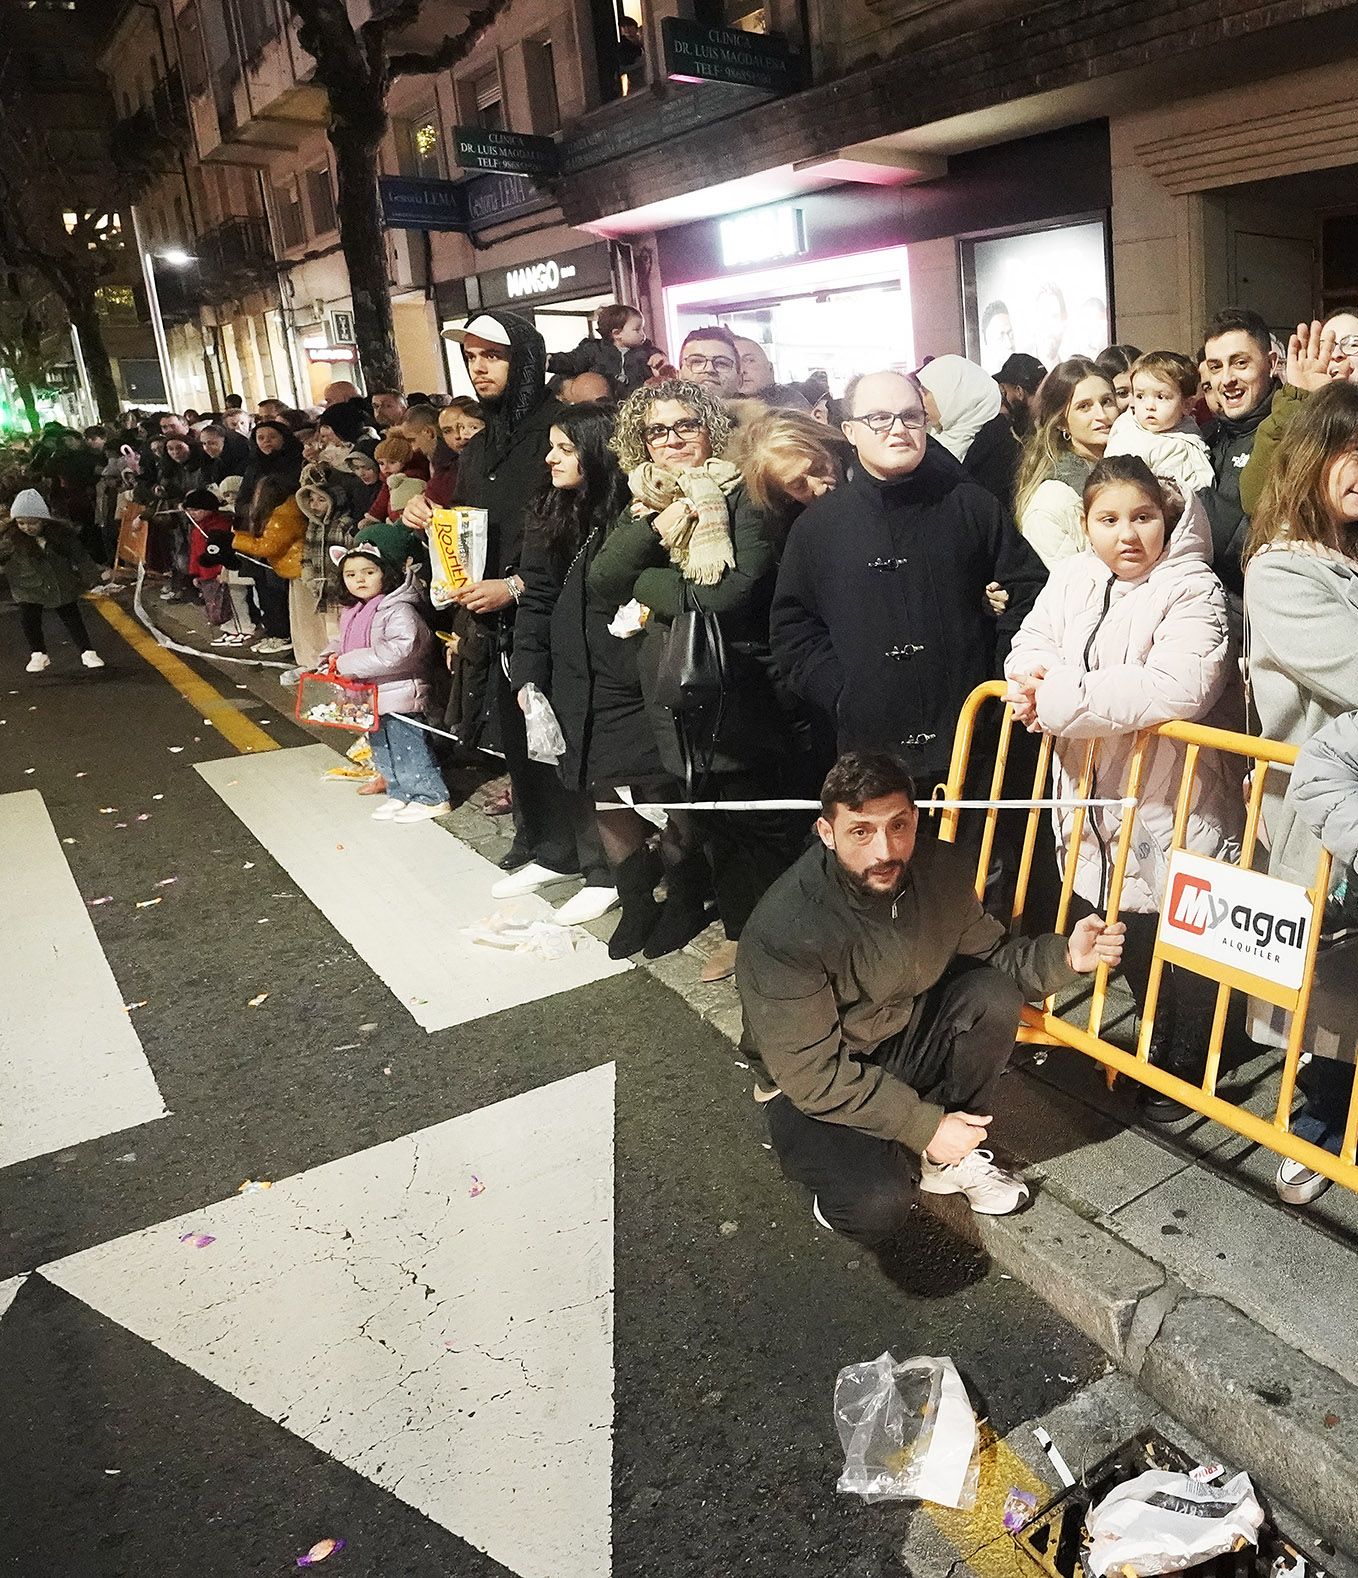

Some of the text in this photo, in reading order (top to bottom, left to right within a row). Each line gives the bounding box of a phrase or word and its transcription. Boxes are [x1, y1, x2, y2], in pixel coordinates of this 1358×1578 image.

[695, 44, 719, 58] LUIS
[477, 144, 497, 156] LUIS
[506, 260, 560, 298] MANGO
[1222, 937, 1281, 963] ALQUILER
